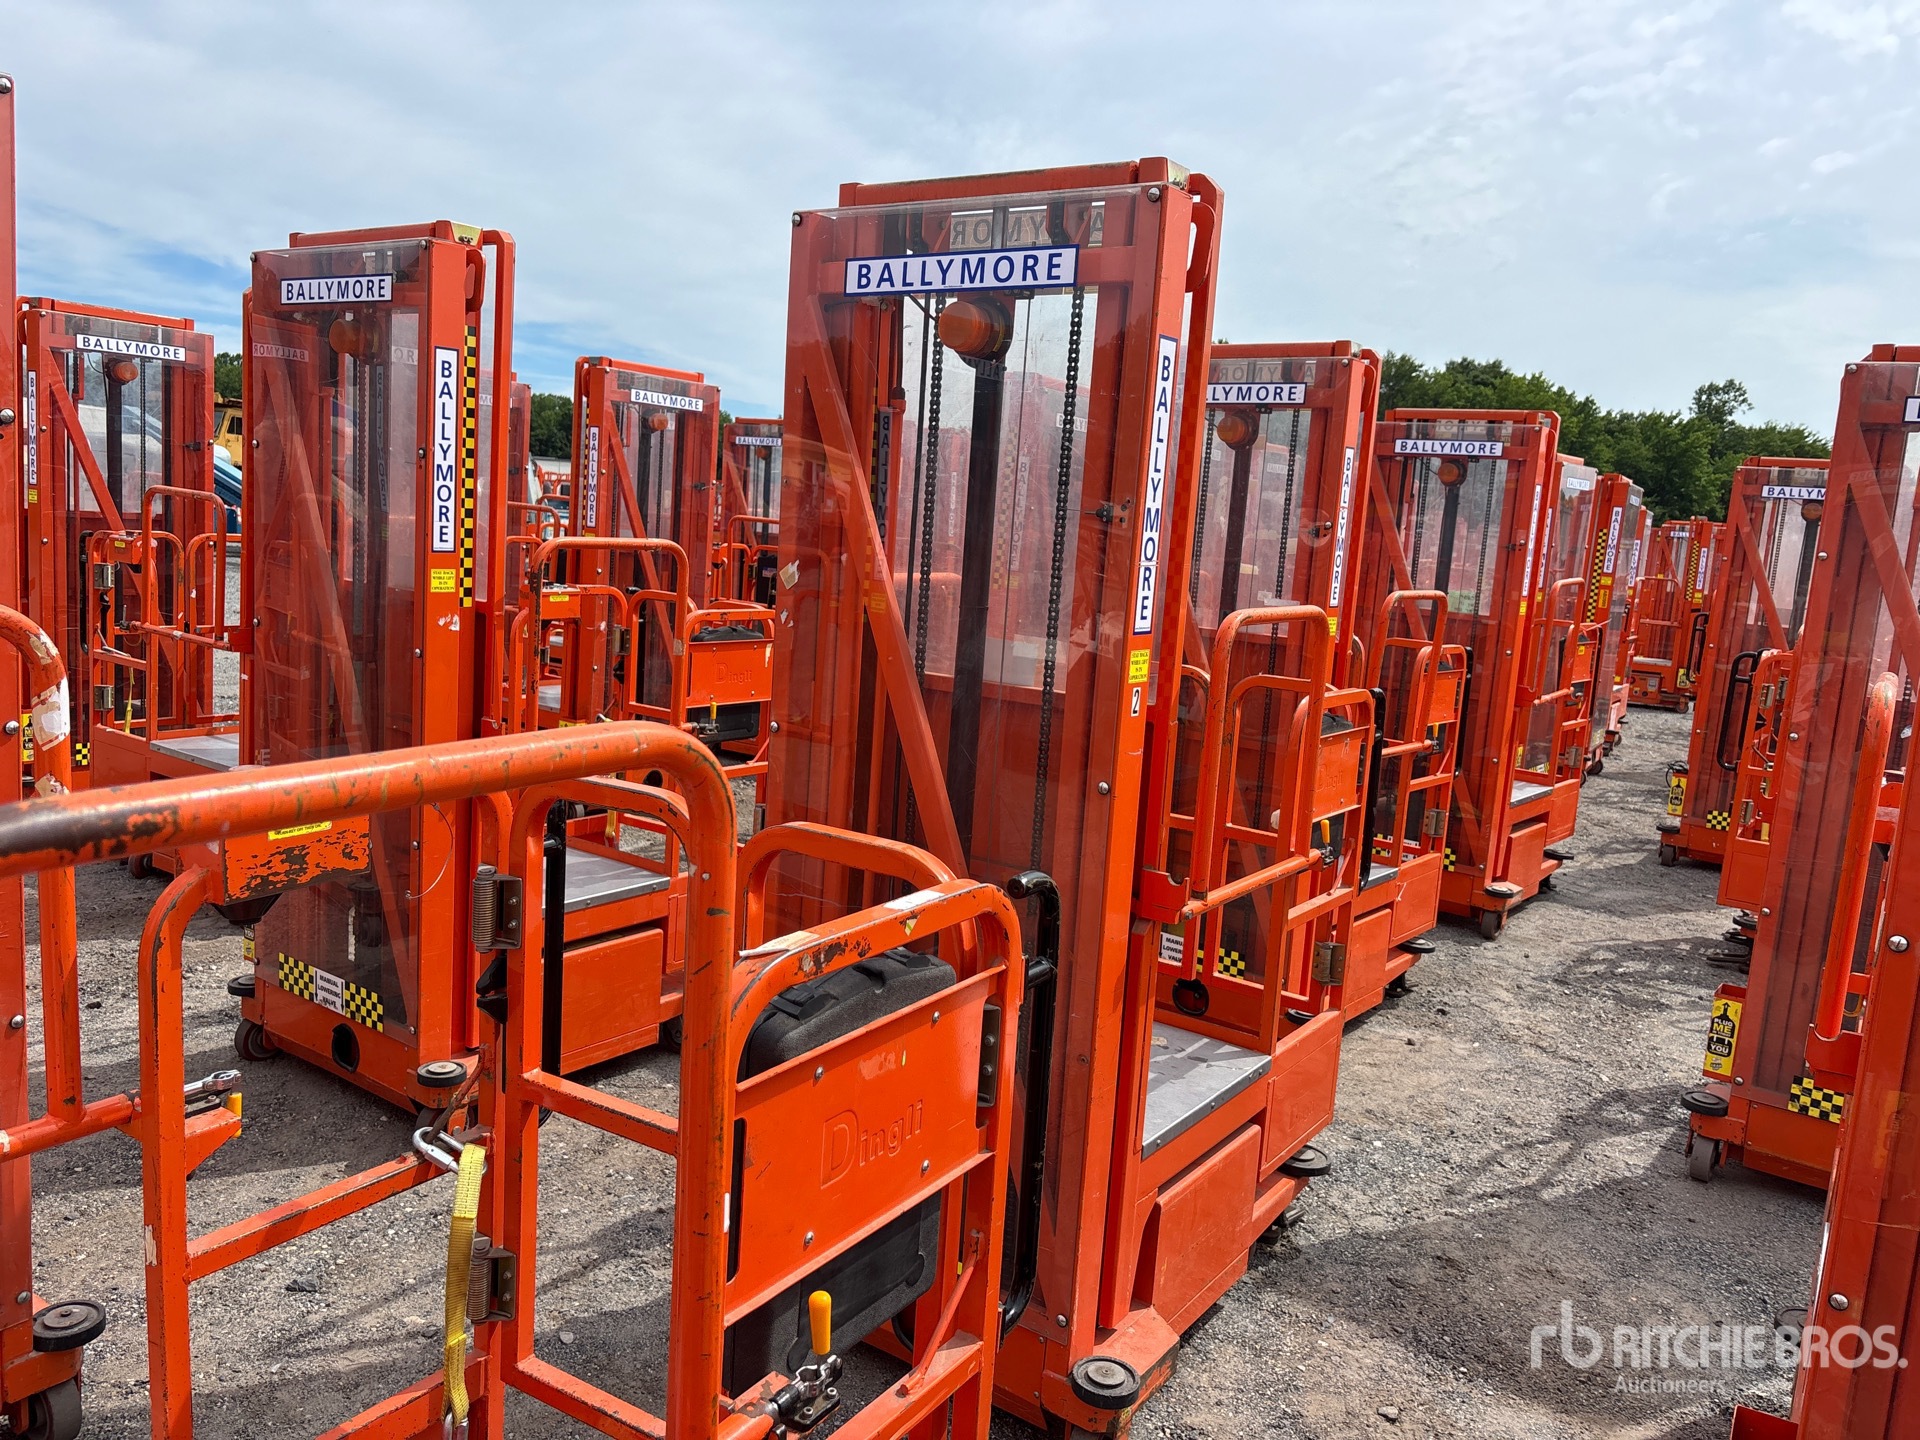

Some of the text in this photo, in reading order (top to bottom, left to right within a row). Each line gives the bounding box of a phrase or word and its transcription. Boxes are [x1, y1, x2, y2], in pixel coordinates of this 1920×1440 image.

[856, 252, 1063, 290] BALLYMORE
[286, 279, 386, 301] BALLYMORE
[82, 336, 181, 359] BALLYMORE
[635, 390, 701, 410] BALLYMORE
[1206, 386, 1298, 402] LYMORE
[737, 436, 780, 446] BALLYMORE
[1399, 441, 1498, 454] BALLYMORE
[436, 360, 453, 544] BALLYMORE
[588, 431, 598, 523] BALLYMORE
[1140, 355, 1171, 620] BALLYMORE
[1767, 487, 1827, 499] BALLYM
[1331, 457, 1352, 601] BALLYMORE
[1606, 510, 1621, 571] BALLYMORE
[1628, 542, 1640, 585] BALLYMORE
[715, 662, 752, 684] Dingli
[1132, 688, 1140, 715] 2
[1165, 937, 1182, 947] MANU
[1167, 955, 1182, 964] VALV
[317, 984, 341, 999] LOWERING
[319, 974, 339, 988] MANUAL
[1713, 1018, 1733, 1027] PLUG
[1713, 1023, 1732, 1034] ME
[1710, 1043, 1730, 1054] YOU
[820, 1098, 923, 1190] Dingli
